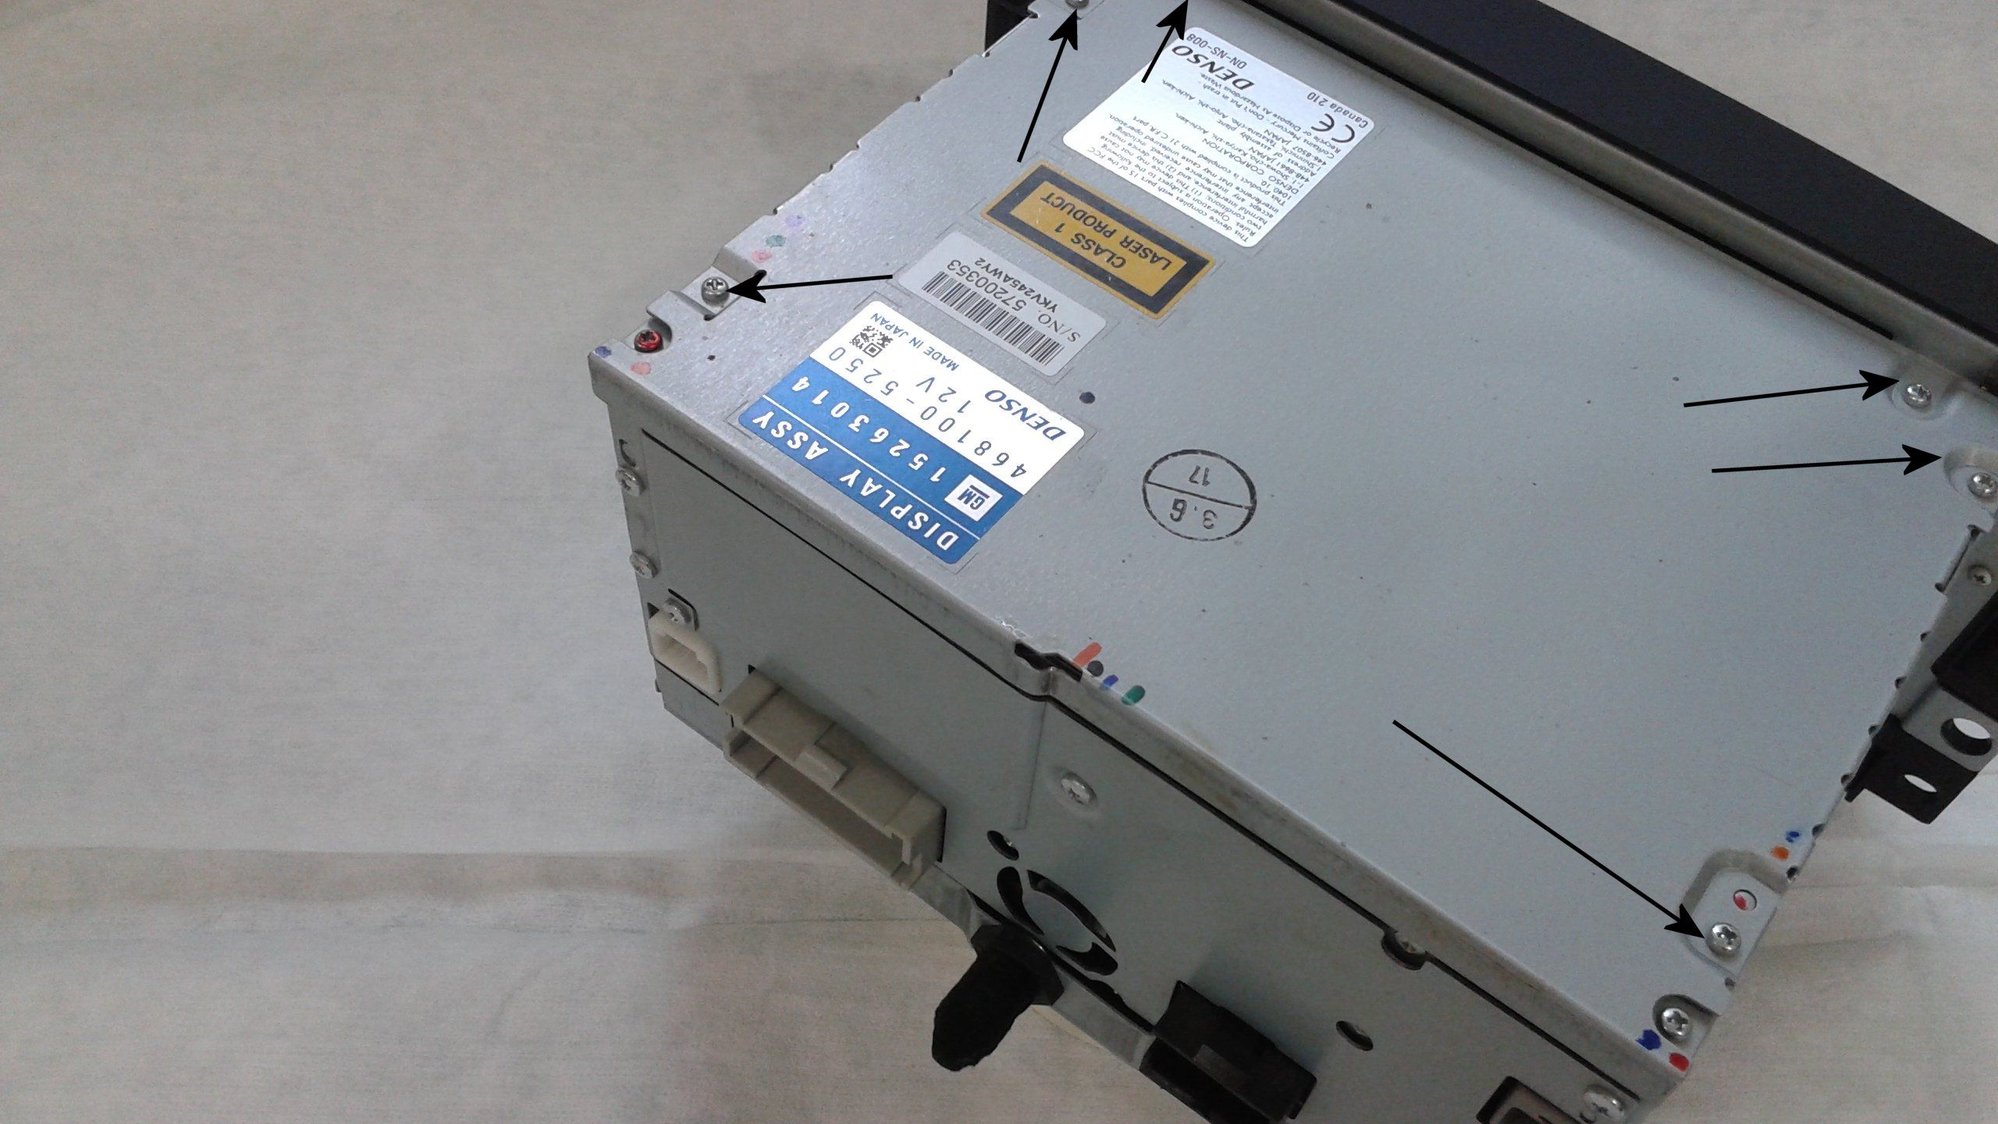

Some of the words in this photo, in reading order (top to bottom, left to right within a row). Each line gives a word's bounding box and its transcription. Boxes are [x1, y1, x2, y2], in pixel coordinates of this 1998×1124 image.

[1171, 45, 1255, 91] DENSO
[1202, 83, 1221, 96] trash
[1223, 85, 1261, 110] Hazardous
[1229, 97, 1244, 109] Put
[1306, 91, 1329, 107] 210
[1262, 107, 1273, 115] As
[1329, 102, 1369, 129] Canada
[1132, 115, 1150, 127] part
[1272, 113, 1302, 132] Dispose
[1108, 130, 1127, 144] must
[1115, 125, 1147, 147] including
[1263, 128, 1293, 146] JAPAN
[1269, 120, 1302, 141] Mercury
[1099, 135, 1120, 149] cause
[1127, 142, 1150, 157] device
[1143, 134, 1180, 157] undesired
[1180, 143, 1197, 155] with
[1239, 131, 1272, 151] assembly
[1302, 138, 1335, 160] Contains
[1313, 135, 1342, 155] Recycle
[1087, 146, 1107, 160] FCC
[1120, 146, 1135, 157] not
[1135, 155, 1151, 166] may
[1151, 155, 1165, 166] this
[1201, 137, 1265, 176] CORPORATION
[1248, 146, 1278, 164] JAPAN
[1107, 157, 1120, 166] the
[1134, 163, 1147, 173] the
[1180, 155, 1202, 169] cause
[1196, 153, 1232, 174] complied
[1287, 157, 1318, 178] Address
[1128, 169, 1139, 179] 15
[1147, 171, 1157, 179] to
[1150, 164, 1174, 180] device
[1176, 171, 1192, 181] and
[1184, 166, 1230, 194] interference
[1202, 167, 1218, 178] may
[1232, 172, 1240, 180] is
[1140, 175, 1158, 188] part
[1157, 176, 1187, 194] subject
[1172, 178, 1190, 191] This
[1217, 176, 1234, 188] that
[1239, 176, 1272, 196] product
[1268, 175, 1300, 195] DENSO
[1157, 185, 1174, 197] with
[1231, 193, 1246, 203] any
[1234, 185, 1280, 214] interference
[1175, 195, 1208, 217] complies
[1192, 197, 1231, 222] Operation
[1270, 194, 1287, 207] This
[1040, 192, 1118, 239] PRODUCT
[1237, 206, 1269, 226] harmful
[1248, 202, 1277, 219] accept
[1054, 222, 1066, 233] 1
[1208, 215, 1233, 231] device
[1246, 219, 1263, 231] two
[1234, 229, 1249, 243] This
[1070, 232, 1127, 269] CLASS
[1119, 235, 1173, 271] LASER
[946, 259, 1027, 312] 57200353
[974, 257, 1058, 314] YKV245AWY2
[870, 312, 909, 338] JAPAN
[1037, 310, 1081, 343] S/NO.
[908, 336, 925, 349] IN
[922, 346, 960, 372] MADE
[915, 376, 972, 414] 12V
[828, 346, 1027, 478] 468100-5250
[984, 389, 1067, 441] DENSO
[751, 410, 829, 460] ASSY
[791, 376, 946, 482] 15263014
[1188, 465, 1211, 487] 17
[956, 488, 986, 511] GM
[839, 468, 959, 551] DISPLAY
